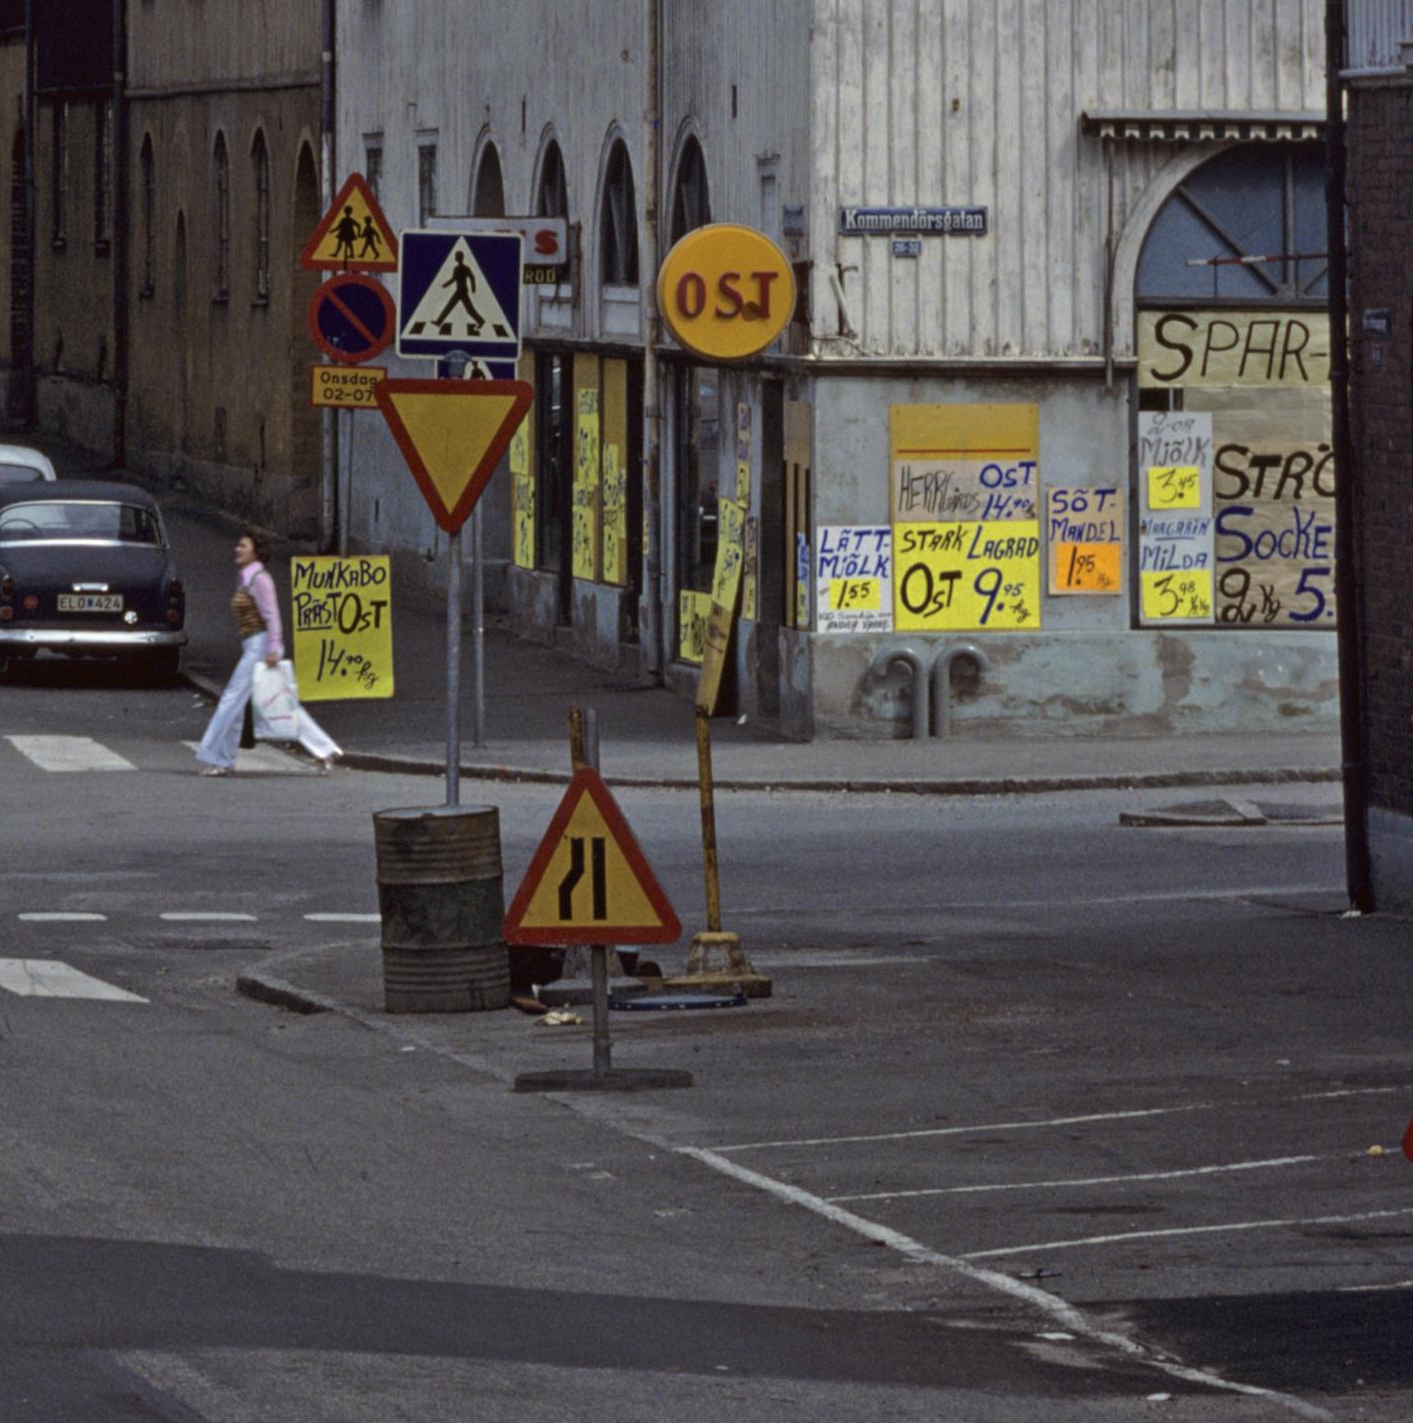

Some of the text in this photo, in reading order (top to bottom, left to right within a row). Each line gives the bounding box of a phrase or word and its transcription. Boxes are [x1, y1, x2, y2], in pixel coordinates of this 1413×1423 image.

[844, 209, 983, 232] Kommendörsgatan
[676, 270, 779, 319] OST
[323, 387, 373, 402] 02-07
[979, 460, 1037, 488] OST
[901, 524, 1039, 561] STARK LAGRAD
[1050, 517, 1121, 543] MANDEL
[1215, 505, 1336, 563] SOCKE
[294, 560, 386, 589] MUNKABO
[95, 597, 121, 610] 424
[900, 562, 963, 618] OST
